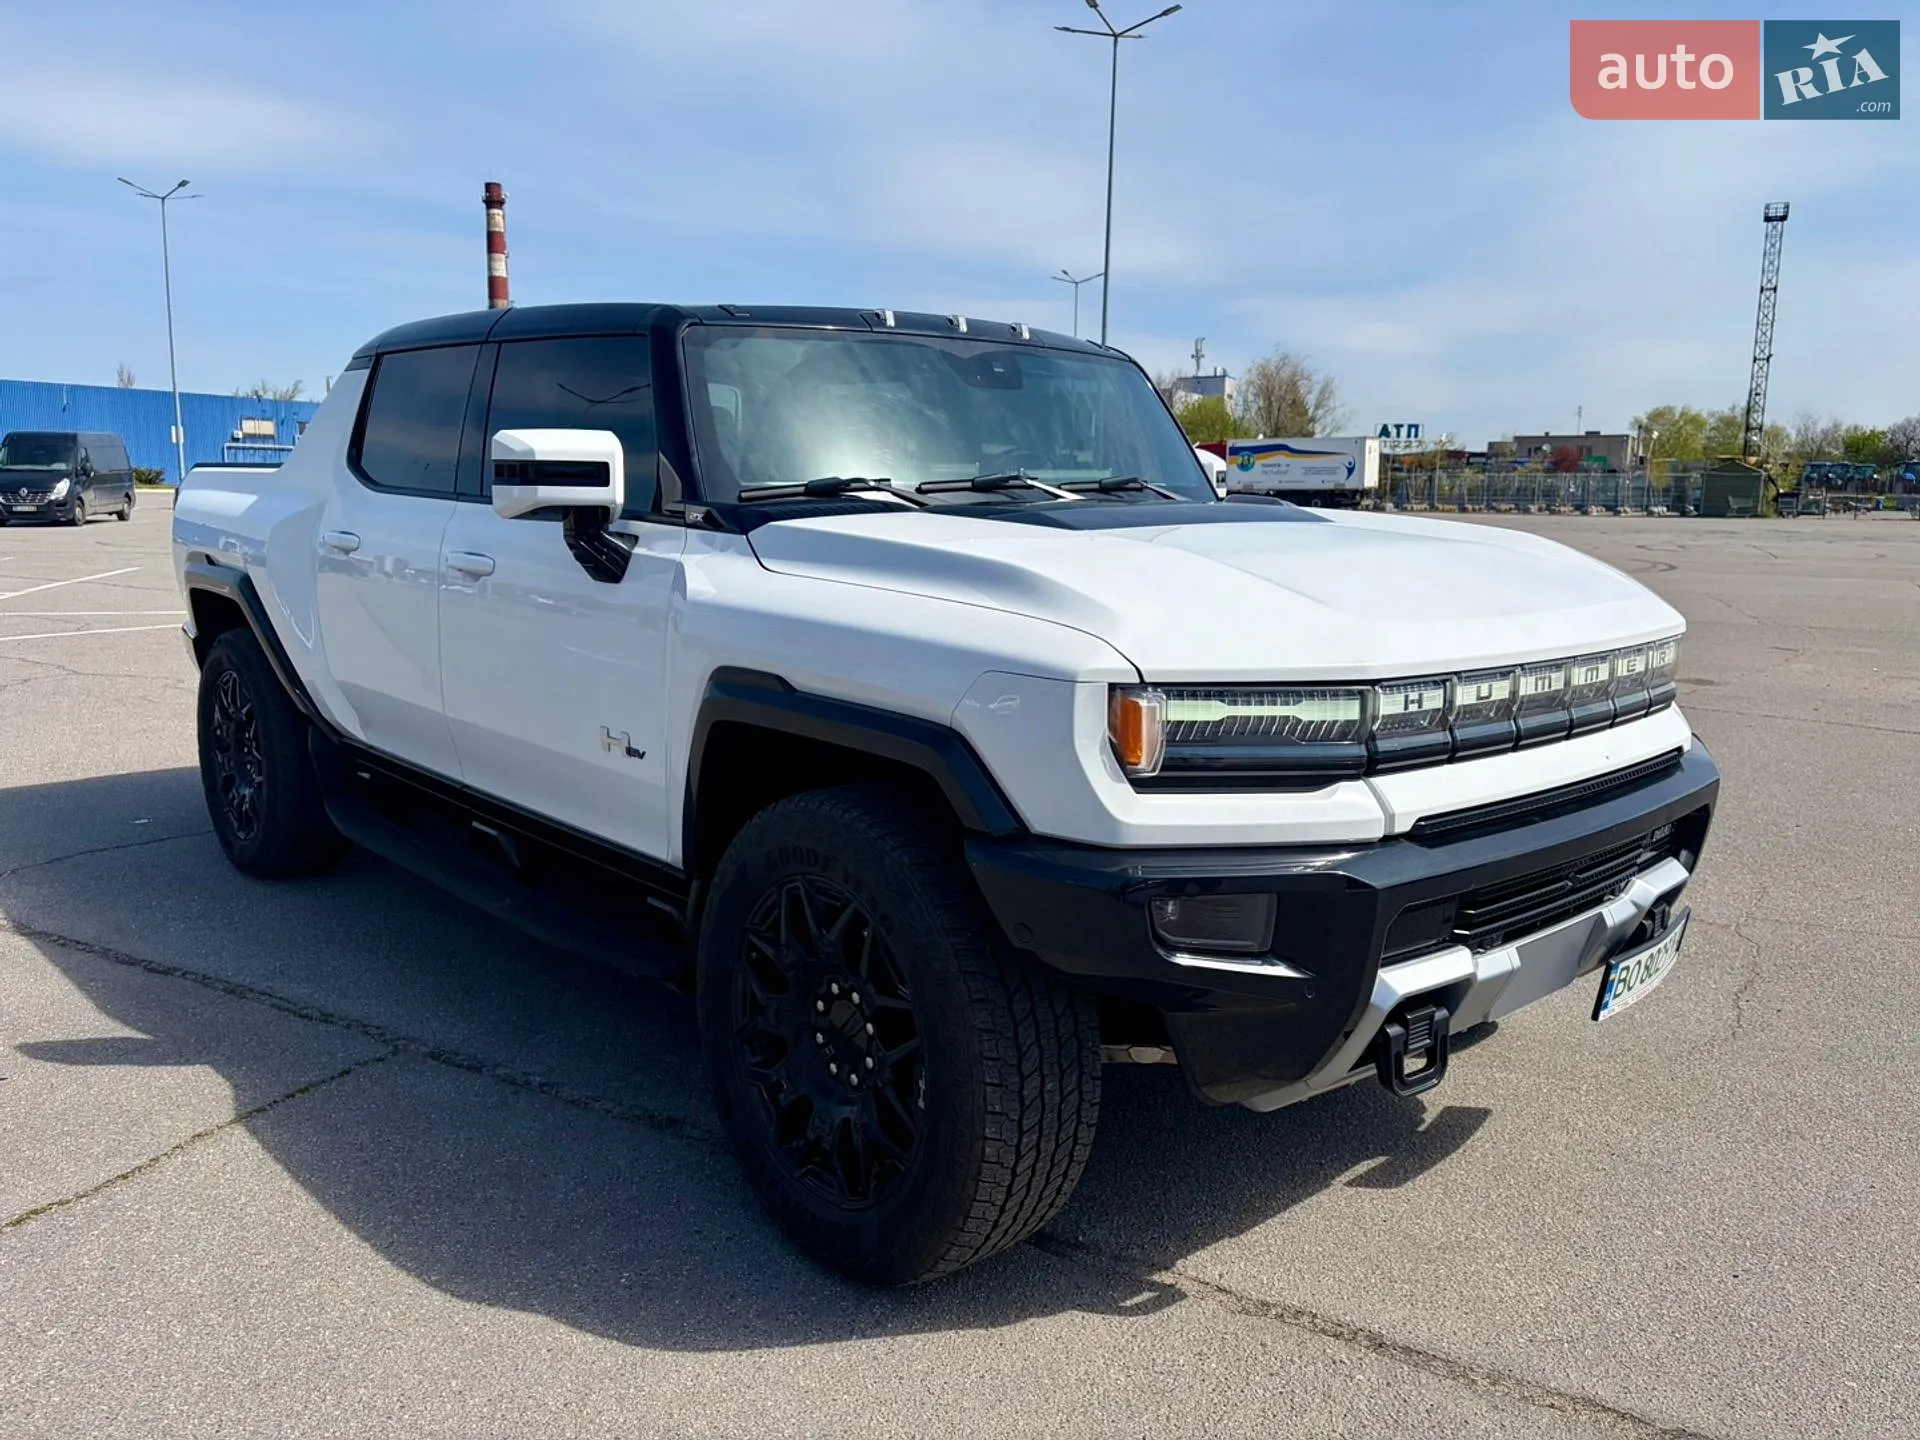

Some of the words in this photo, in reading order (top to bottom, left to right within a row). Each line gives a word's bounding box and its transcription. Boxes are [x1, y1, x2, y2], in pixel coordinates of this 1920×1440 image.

[1379, 423, 1419, 438] АТП
[1403, 649, 1669, 711] HUMMER
[1612, 958, 1642, 999] BO
